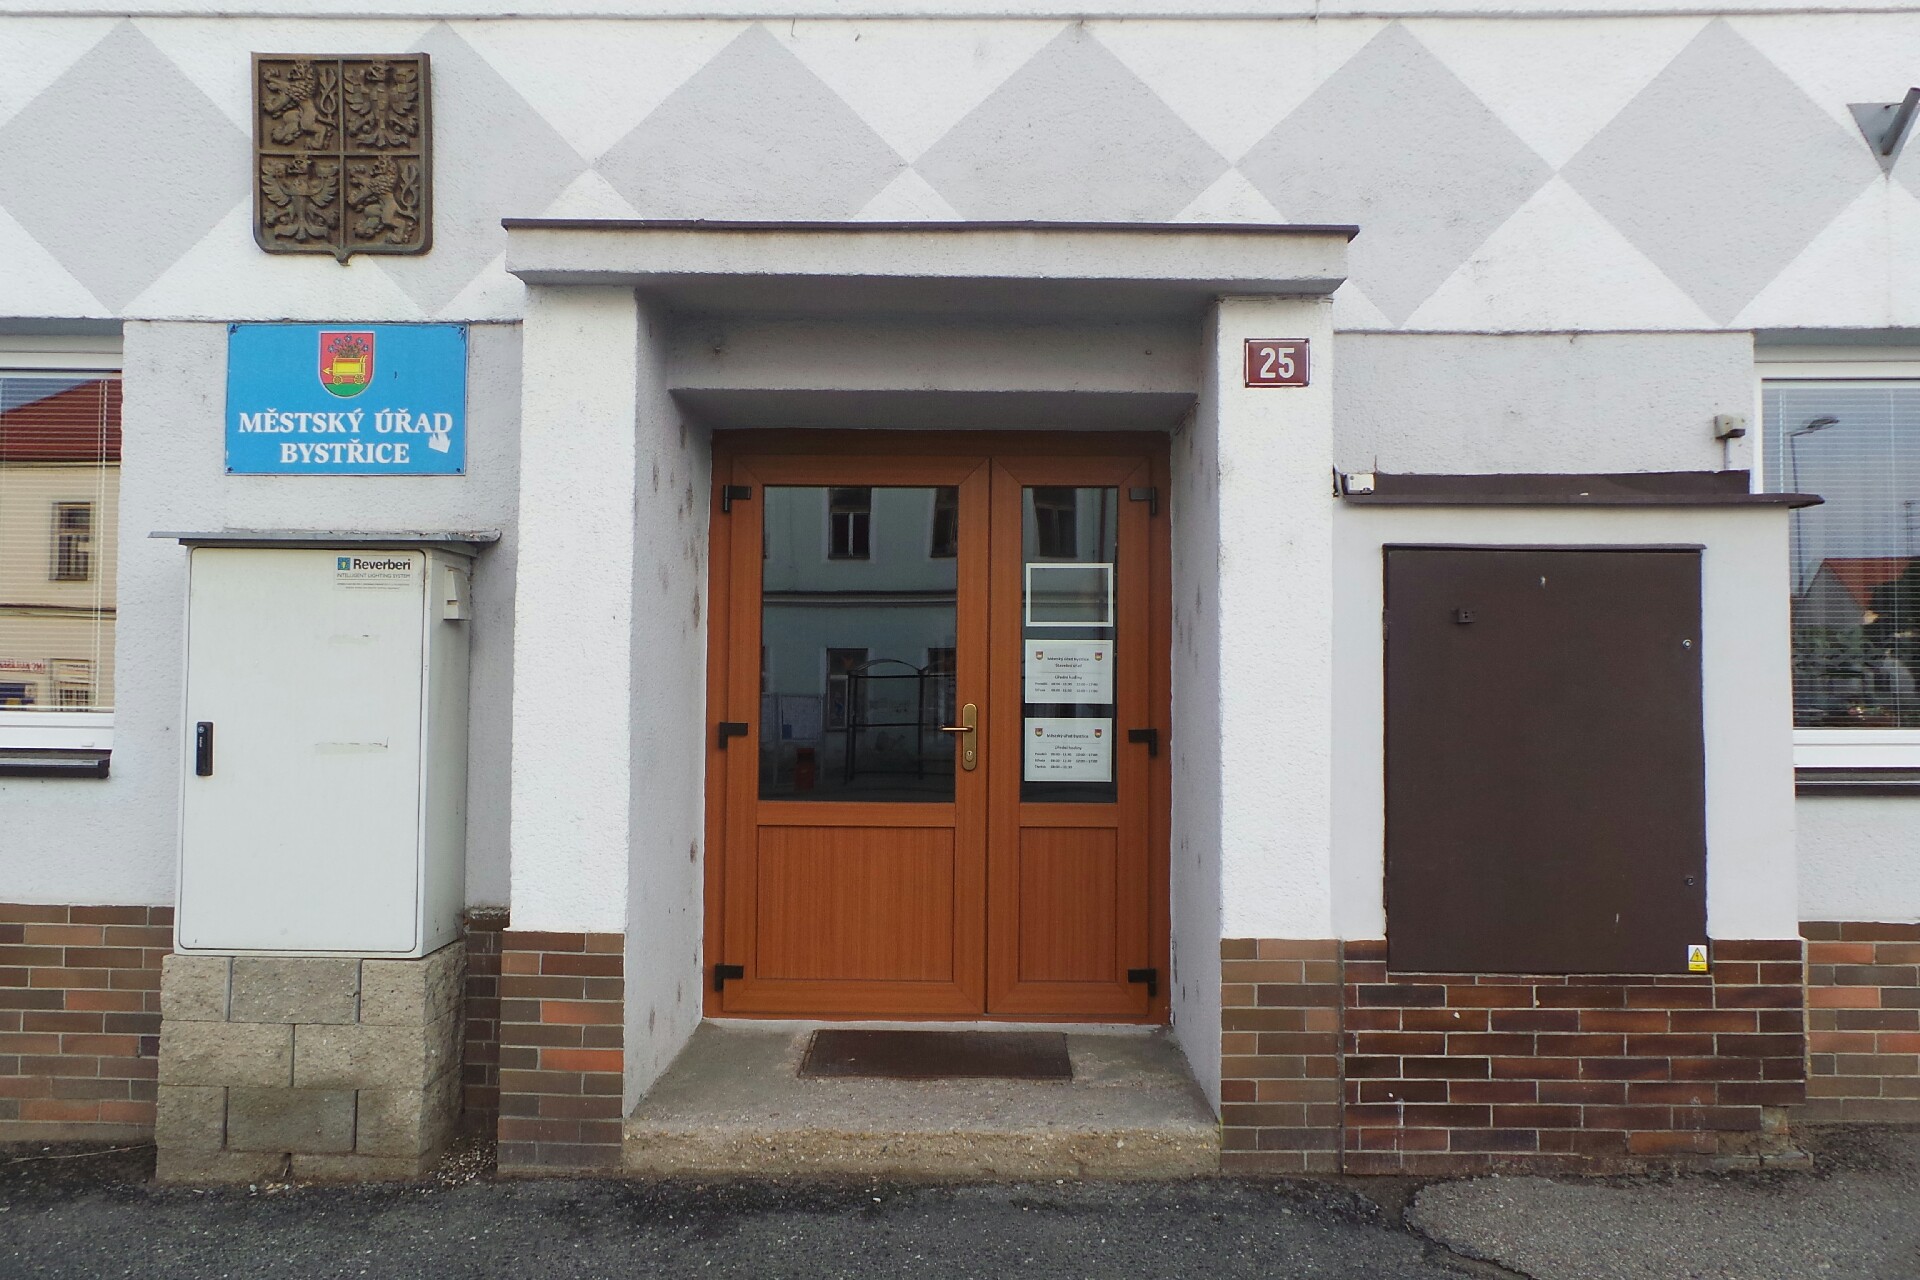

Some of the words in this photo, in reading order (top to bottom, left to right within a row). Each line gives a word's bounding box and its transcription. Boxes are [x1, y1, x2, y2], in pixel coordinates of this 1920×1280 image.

[1260, 347, 1295, 379] 25
[238, 408, 365, 434] MĚSTSKÝ
[374, 408, 453, 434] ÚŘAD
[280, 438, 410, 464] BYSTŘICE
[353, 558, 411, 570] Reverberi
